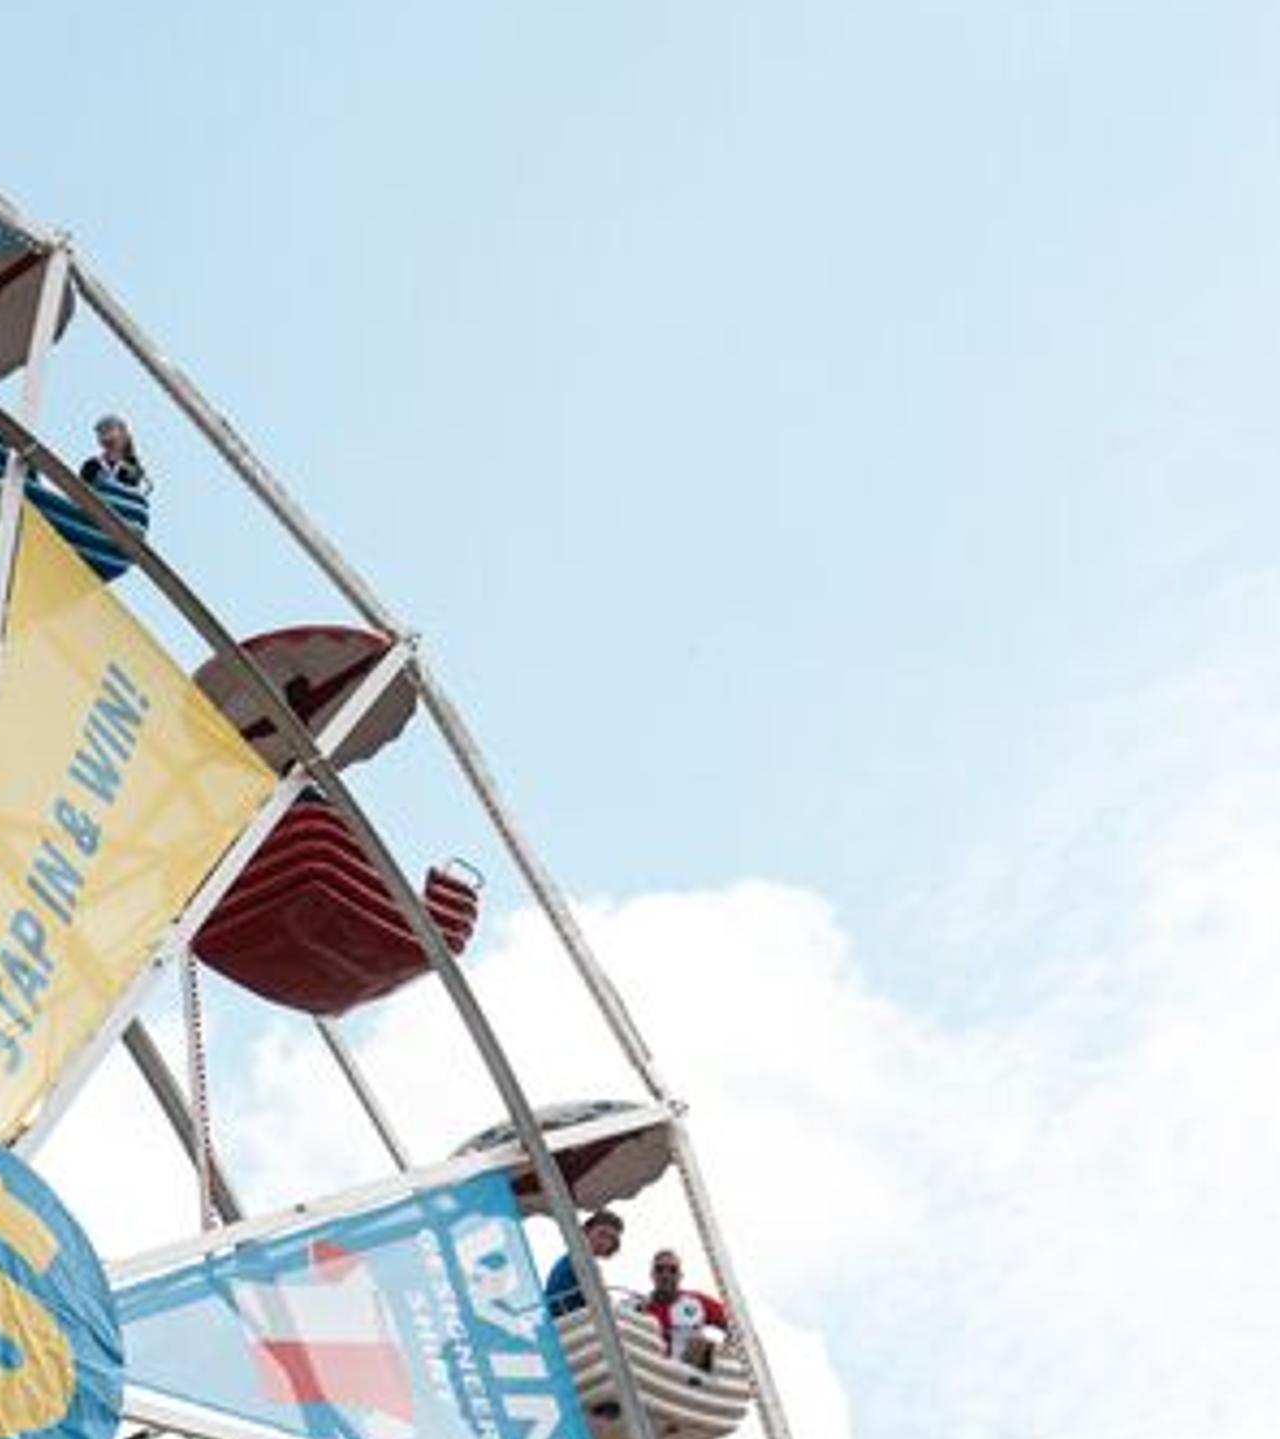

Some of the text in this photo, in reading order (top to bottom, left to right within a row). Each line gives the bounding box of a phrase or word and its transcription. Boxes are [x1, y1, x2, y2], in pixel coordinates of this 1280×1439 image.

[67, 661, 150, 806] WIN!
[54, 796, 103, 857] &
[26, 837, 85, 927] IN
